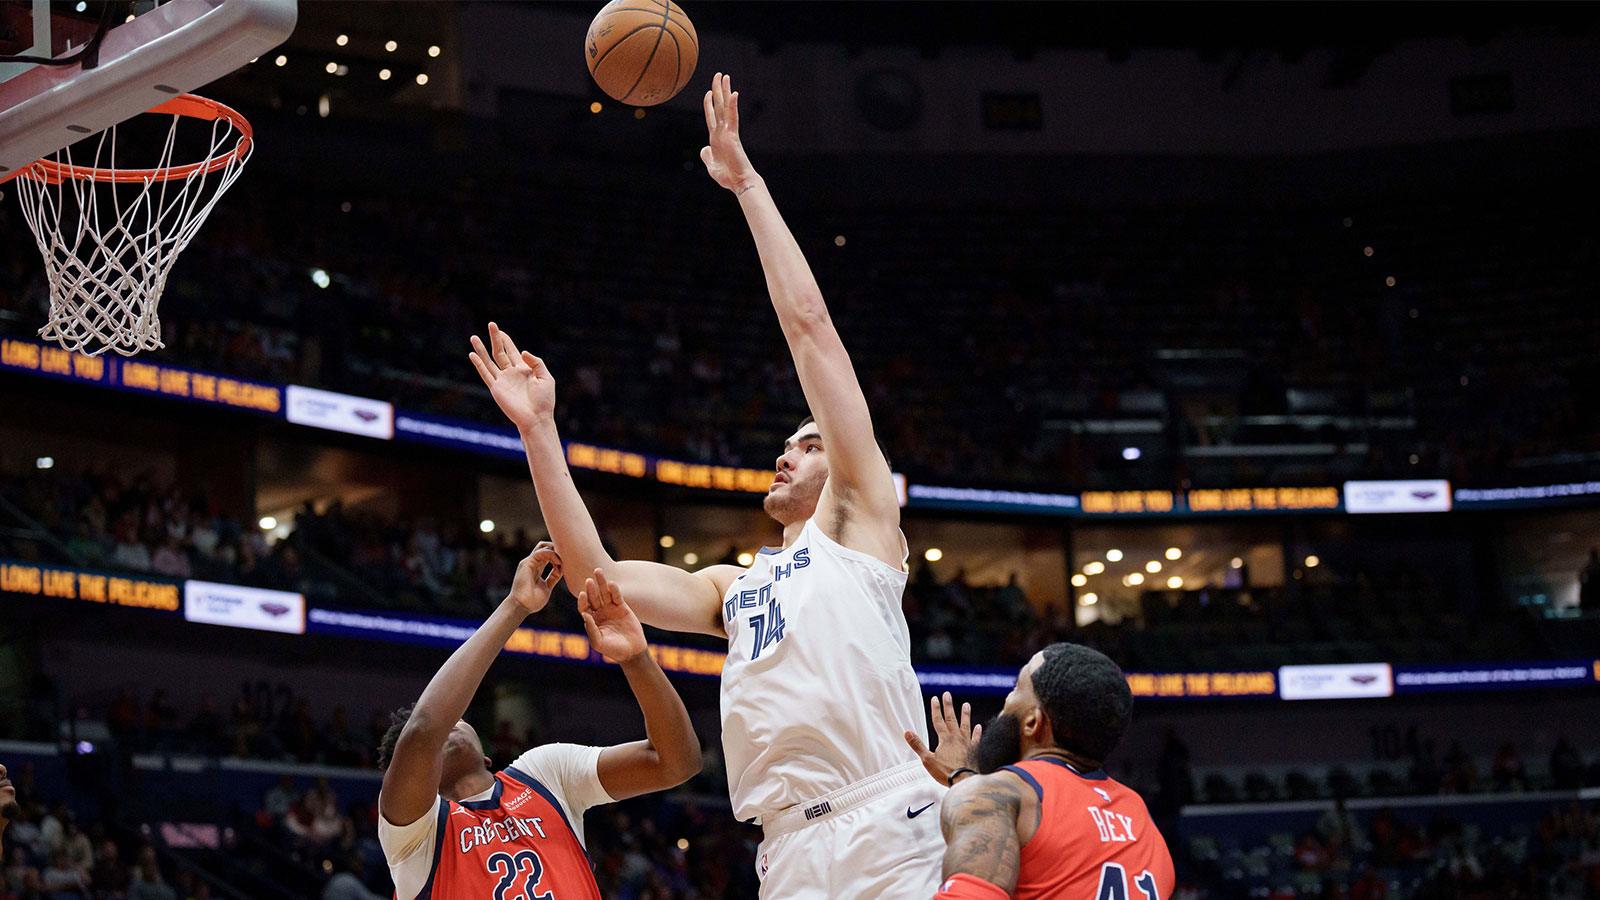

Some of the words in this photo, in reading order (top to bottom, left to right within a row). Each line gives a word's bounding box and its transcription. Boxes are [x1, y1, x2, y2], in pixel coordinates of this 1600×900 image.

[1, 339, 40, 369] LONG
[41, 345, 72, 375] LIVE
[73, 351, 104, 381] YOU
[123, 361, 160, 391] LONG
[160, 367, 190, 397] LIVE
[192, 372, 216, 402] THE
[217, 376, 281, 413] PELICANS
[567, 442, 596, 470] LONG
[598, 448, 621, 475] LIVE
[622, 451, 646, 479] YOU
[656, 458, 685, 486] LONG
[1081, 490, 1114, 513] LONG
[1115, 490, 1143, 513] LIVE
[1144, 489, 1174, 513] YOU
[1188, 488, 1223, 512] LONG
[1223, 488, 1252, 511] LIVE
[1253, 487, 1276, 509] THE
[1276, 486, 1339, 510] PELICANS
[1, 563, 42, 595] LONG
[43, 568, 77, 600] LIVE
[78, 572, 107, 603] THE
[108, 576, 179, 612] PELICANS
[725, 547, 811, 623] MEMHS
[535, 629, 562, 658] LIVE
[562, 633, 590, 660] YOU
[748, 597, 786, 661] 14
[1126, 673, 1155, 697] ONG
[1155, 673, 1185, 697] LIVE
[1185, 673, 1210, 697] THE
[1211, 671, 1275, 696] PELICANS
[460, 816, 547, 853] CRECENT
[1087, 806, 1137, 842] BEY
[486, 849, 555, 900] 22
